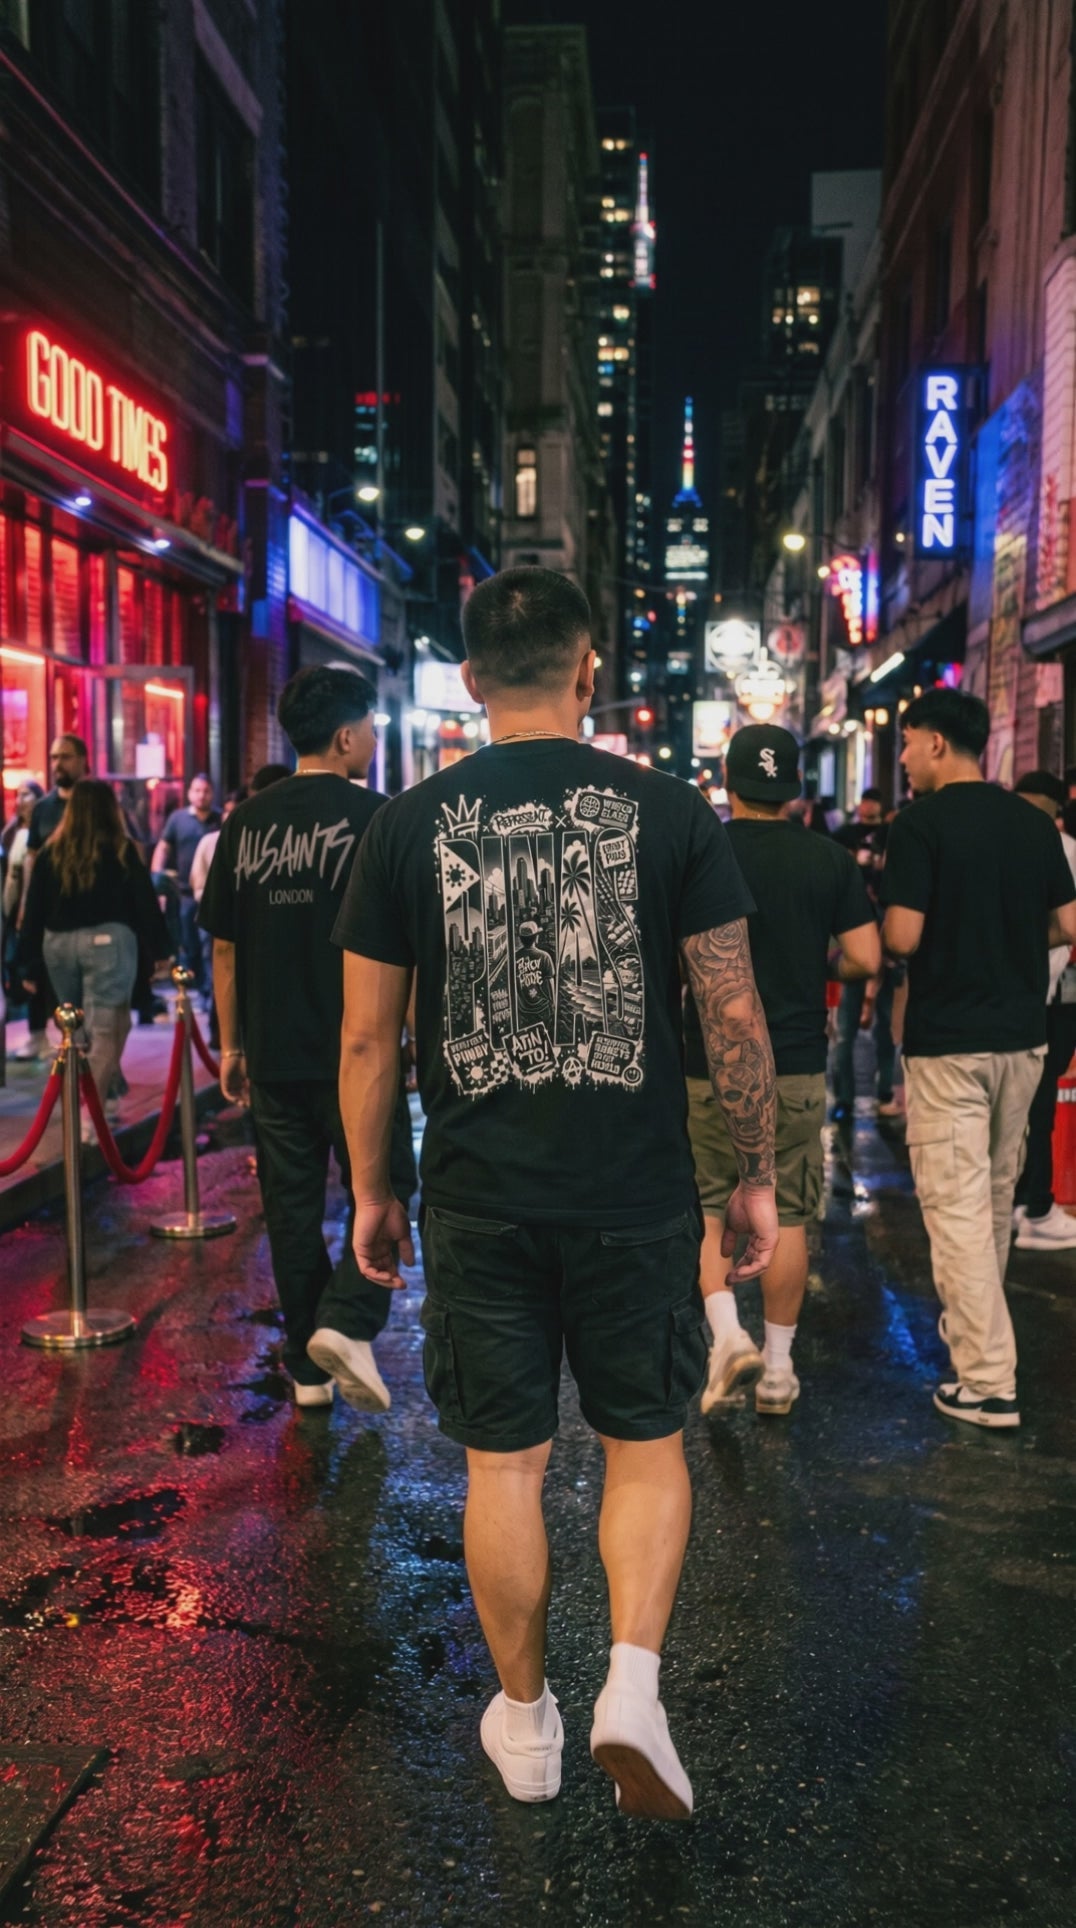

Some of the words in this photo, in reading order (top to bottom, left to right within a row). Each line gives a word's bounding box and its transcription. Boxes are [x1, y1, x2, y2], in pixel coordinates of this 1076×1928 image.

[27, 331, 103, 451] GOOD
[106, 385, 168, 492] TIMES
[922, 375, 959, 548] RAVEN
[268, 888, 315, 905] LONDON
[511, 1027, 543, 1056] ATIN
